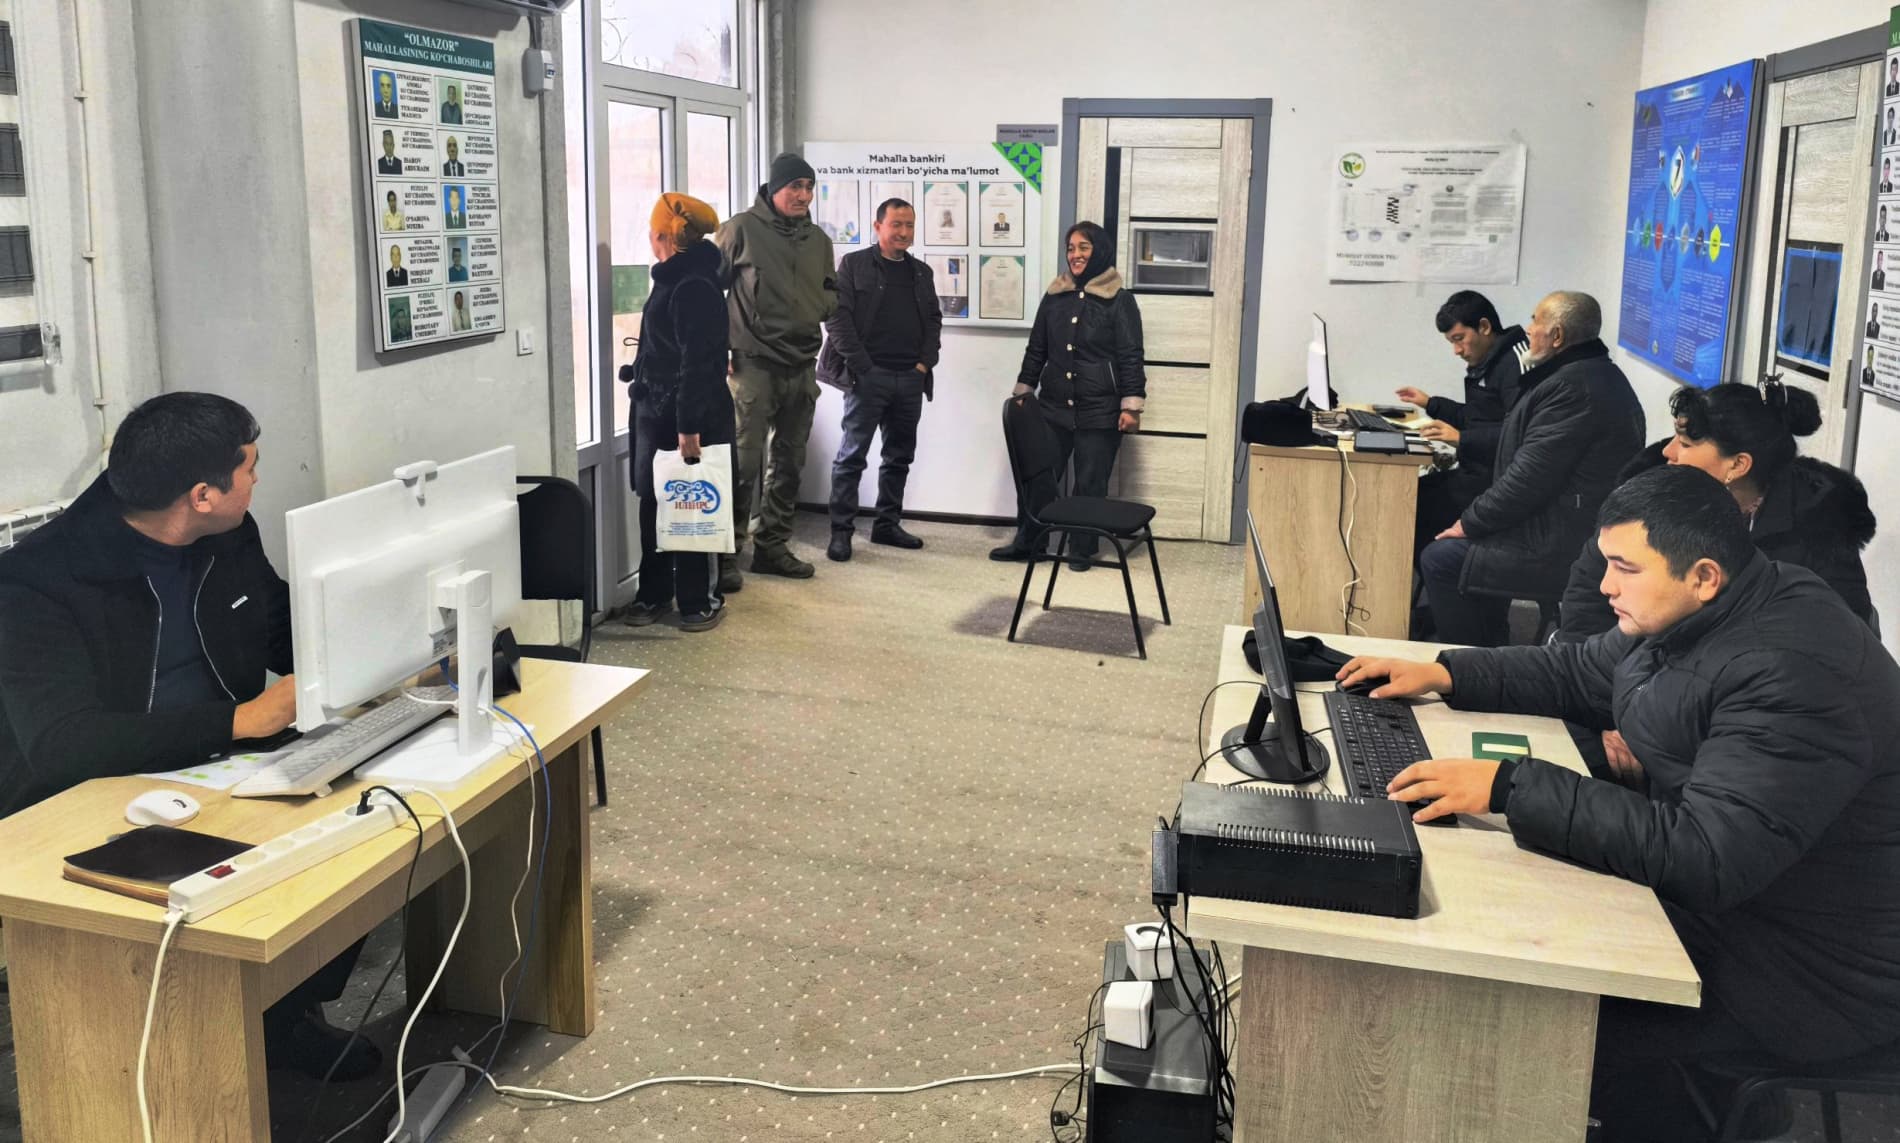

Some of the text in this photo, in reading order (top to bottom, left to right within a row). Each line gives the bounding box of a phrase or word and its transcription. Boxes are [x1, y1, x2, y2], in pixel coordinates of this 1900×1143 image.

[404, 32, 460, 52] “OLMAZOR”
[364, 41, 429, 60] MAHALLASINING
[869, 154, 945, 163] Mahalla bankiri
[830, 166, 854, 174] bank
[856, 166, 905, 175] xizmatlari
[907, 166, 949, 177] bo‘yicha
[951, 166, 999, 175] ma’lumot
